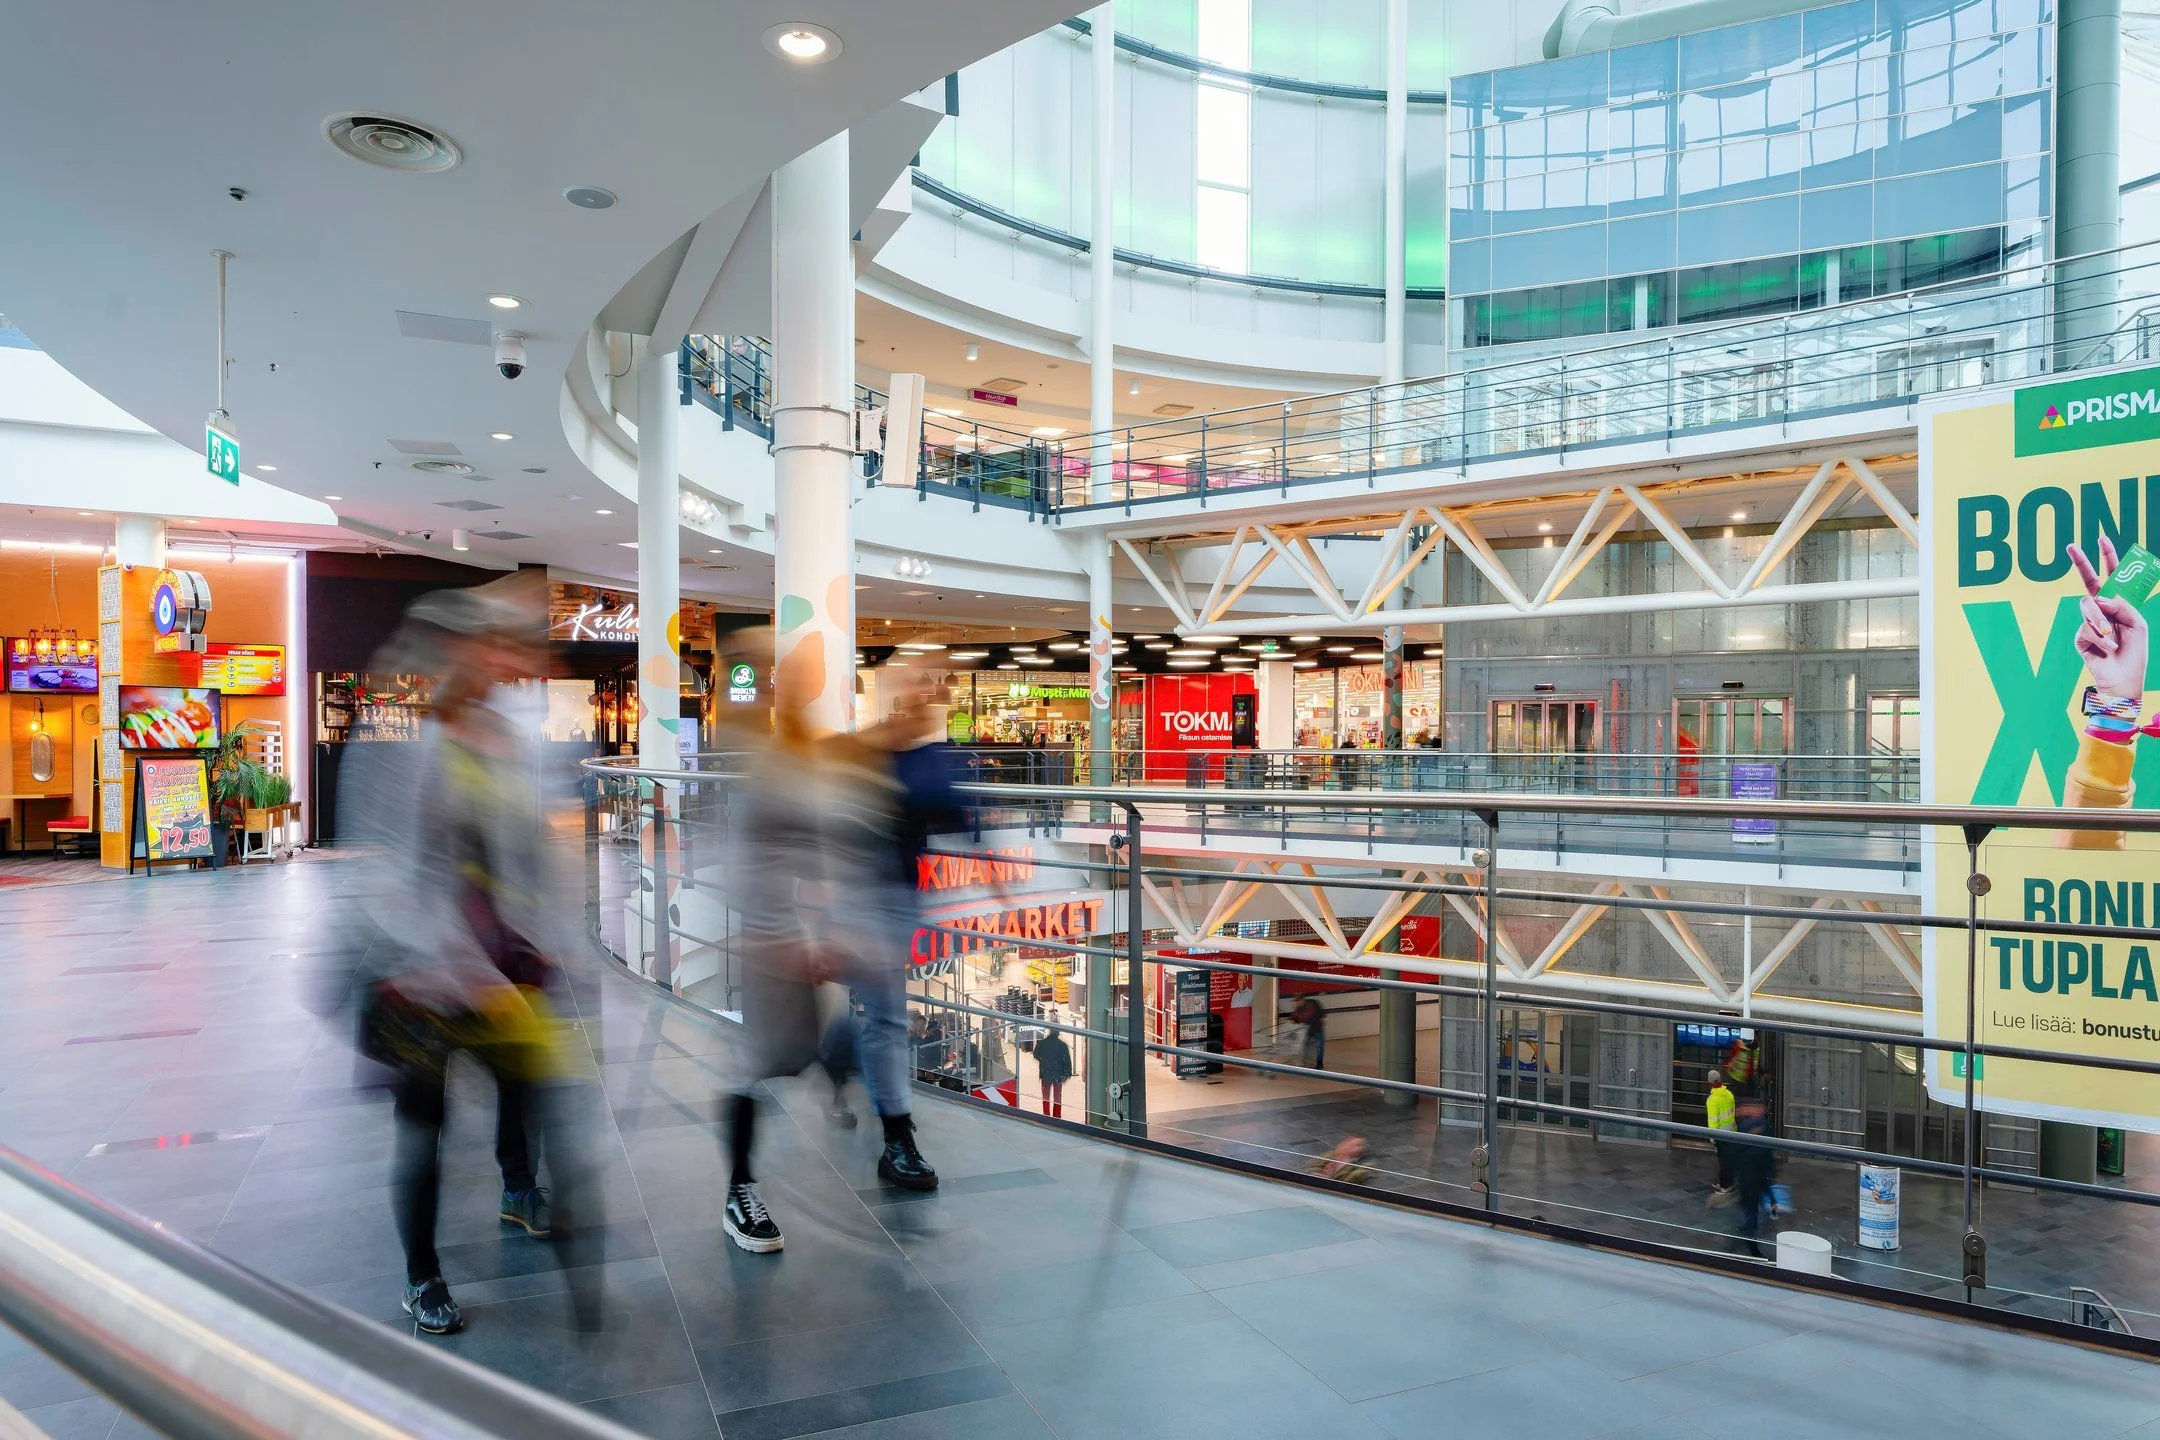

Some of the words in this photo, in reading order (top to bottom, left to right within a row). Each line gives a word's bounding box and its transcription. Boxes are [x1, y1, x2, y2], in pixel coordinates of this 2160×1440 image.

[1958, 475, 2160, 587] BON
[730, 687, 756, 695] BROOKLYN
[1160, 710, 1233, 732] TOKM
[1179, 733, 1200, 741] Fiksun
[160, 826, 209, 853] 12,50
[1990, 937, 2159, 1002] TUPLA
[1993, 1010, 2026, 1029] Lue
[2031, 1013, 2077, 1034] lisää:
